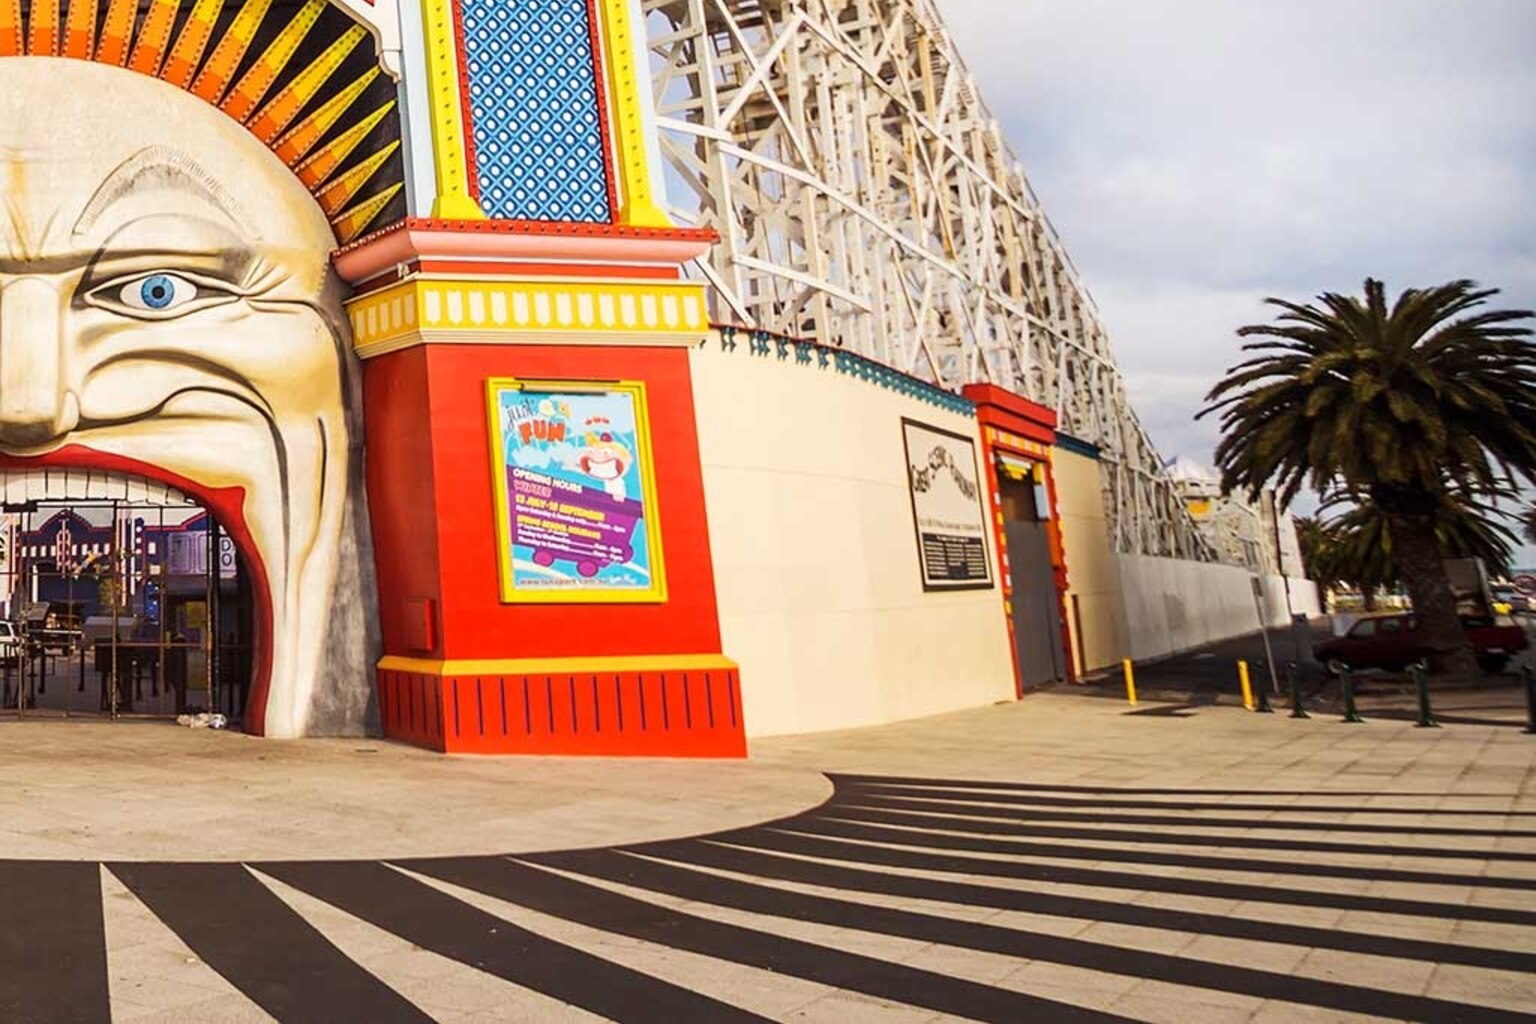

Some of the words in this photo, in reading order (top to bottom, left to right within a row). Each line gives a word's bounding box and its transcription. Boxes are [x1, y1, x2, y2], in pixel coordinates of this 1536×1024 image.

[518, 418, 566, 445] FUN
[512, 467, 552, 486] OPENING
[552, 479, 583, 494] HOURS
